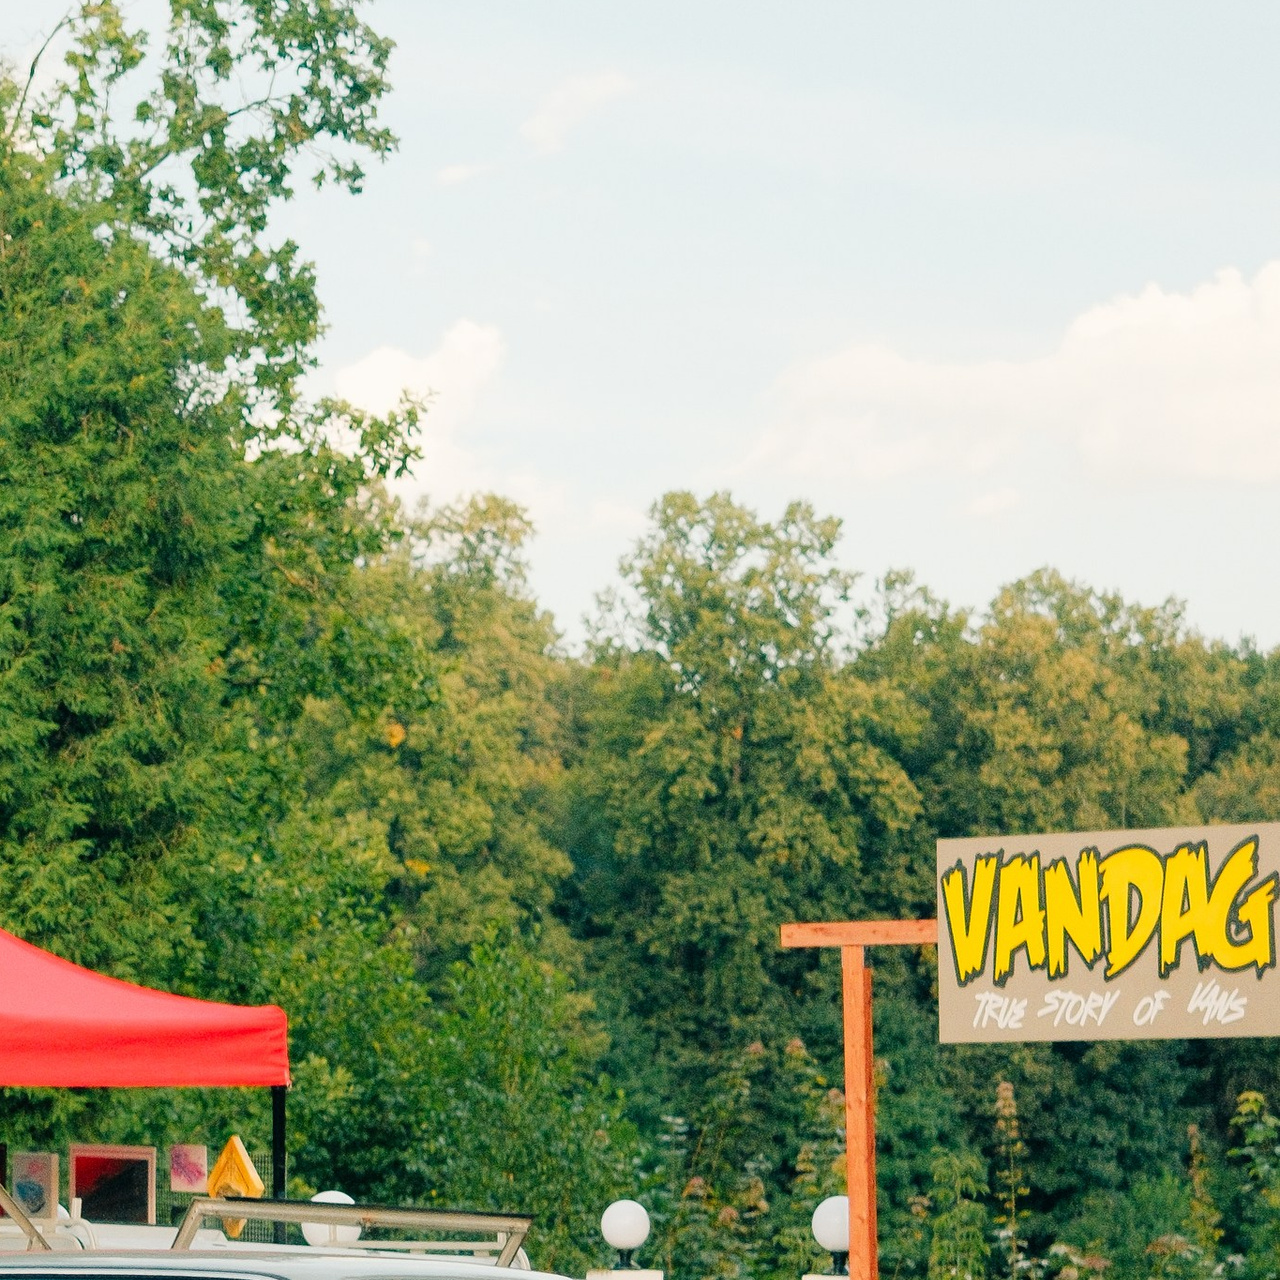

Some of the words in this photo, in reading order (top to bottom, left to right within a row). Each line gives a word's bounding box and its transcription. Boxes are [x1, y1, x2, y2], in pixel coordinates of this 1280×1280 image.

[941, 834, 1279, 988] VANDAG
[972, 990, 1028, 1030] TRUE
[1036, 989, 1121, 1028] STORY
[1133, 989, 1172, 1026] OF
